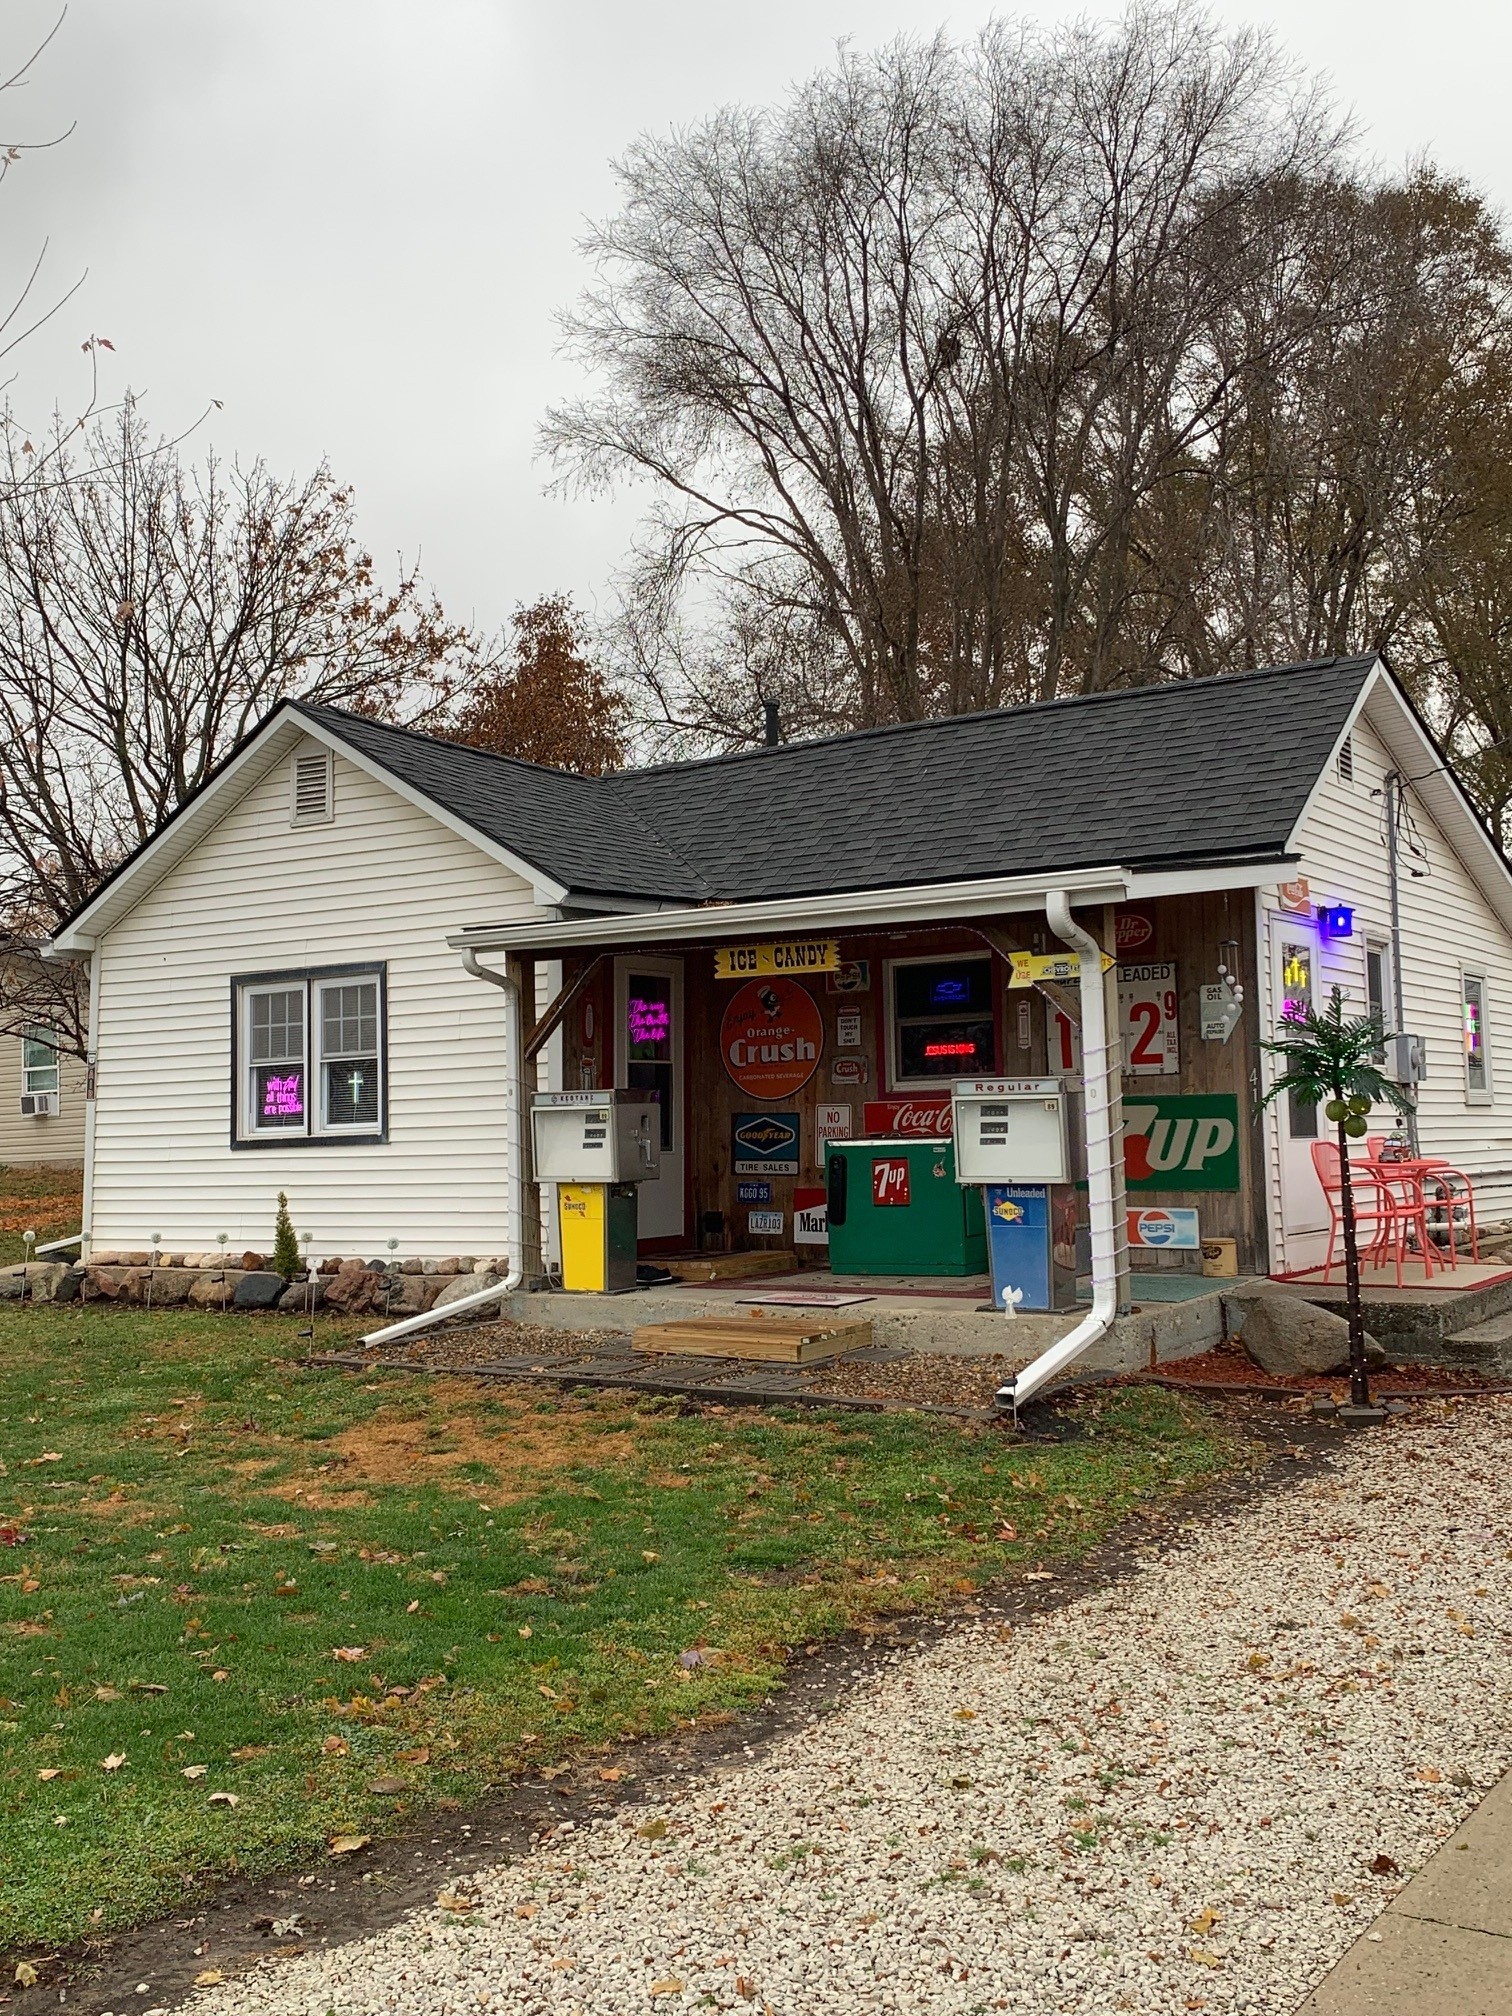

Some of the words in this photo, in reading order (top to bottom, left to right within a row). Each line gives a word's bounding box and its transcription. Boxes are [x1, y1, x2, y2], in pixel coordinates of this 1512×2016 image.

[1121, 918, 1138, 930] Dr
[1115, 928, 1149, 943] pper
[729, 949, 757, 971] ICE
[774, 944, 828, 968] CANDY
[835, 972, 860, 982] PEPSI
[729, 1037, 816, 1068] Crush
[836, 1063, 858, 1073] Crush
[975, 1083, 1040, 1093] Regular
[264, 1105, 277, 1115] are
[827, 1112, 840, 1123] NO
[819, 1126, 849, 1138] PARKING
[740, 1163, 759, 1171] TIRE
[763, 1163, 790, 1171] SALES
[759, 1187, 768, 1199] 95
[1006, 1187, 1046, 1198] Unleaded
[993, 1206, 1024, 1216] SUNOCO
[750, 1217, 781, 1230] LAZR103
[1140, 1223, 1175, 1233] PEPSI
